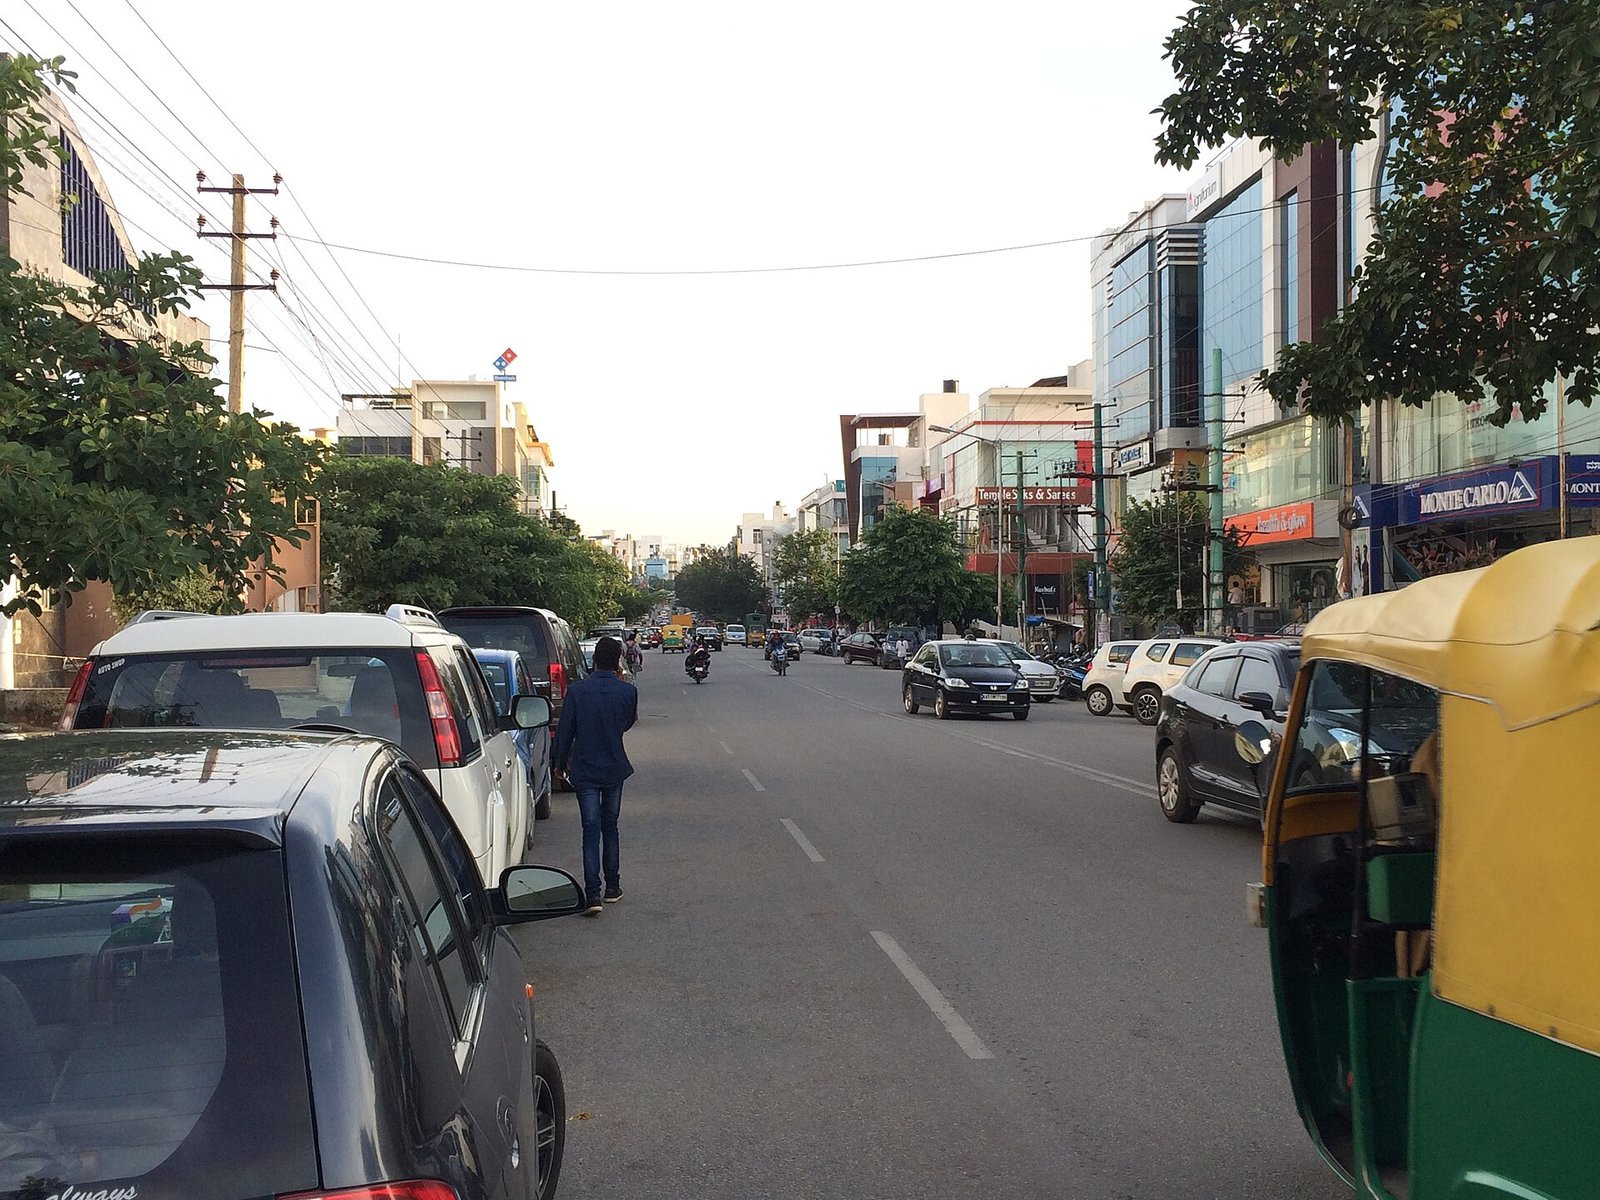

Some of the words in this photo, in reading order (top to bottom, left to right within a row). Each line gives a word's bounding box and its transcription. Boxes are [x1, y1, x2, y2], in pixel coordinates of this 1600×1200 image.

[1011, 488, 1033, 500] Sks
[1035, 488, 1044, 500] &
[1046, 488, 1076, 500] Sarees
[1420, 489, 1464, 514] MONTE
[1463, 481, 1510, 508] CARLO
[97, 664, 111, 675] AUTO
[111, 658, 125, 669] SHOP
